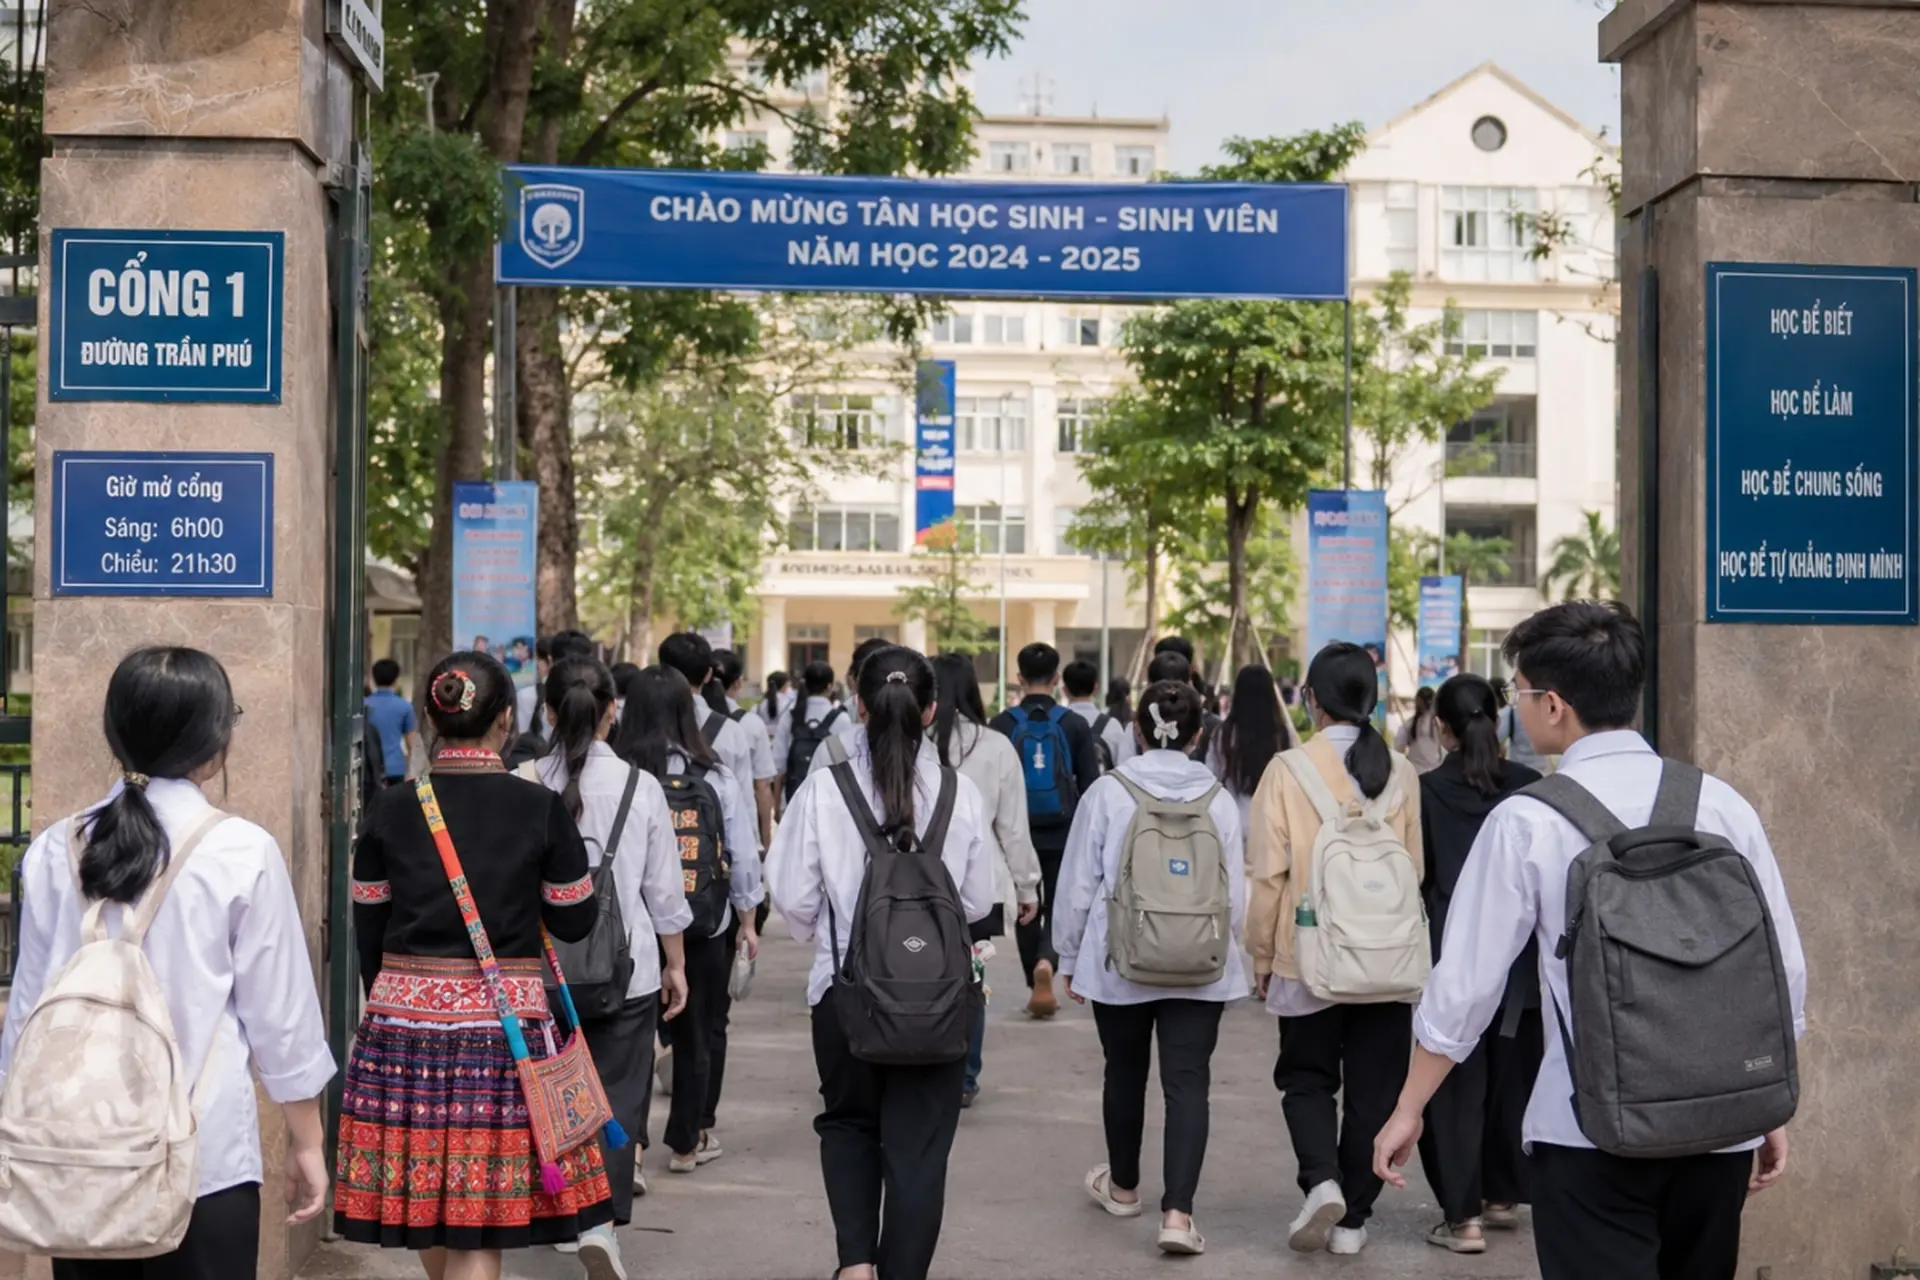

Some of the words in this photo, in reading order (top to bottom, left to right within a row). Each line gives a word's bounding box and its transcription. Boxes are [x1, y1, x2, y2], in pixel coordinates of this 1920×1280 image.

[651, 192, 741, 222] CHÀO
[752, 193, 848, 225] MỪNG
[859, 196, 919, 227] TÂN
[931, 203, 998, 234] HỌC
[1009, 205, 1084, 230] SINH
[1118, 207, 1193, 231] SINH
[1204, 203, 1277, 232] VIÊN
[788, 235, 859, 265] NĂM
[871, 243, 938, 273] HỌC
[948, 244, 1028, 268] 2024
[1061, 246, 1140, 271] 2025
[89, 251, 209, 317] CỔNG
[226, 272, 244, 317] 1
[1771, 309, 1799, 339] HỌC
[1803, 299, 1820, 334] ĐỂ
[1824, 302, 1852, 335] BIẾT
[81, 337, 148, 365] ĐƯỜNG
[155, 336, 206, 366] TRẦN
[213, 339, 252, 367] PHÚ
[1771, 390, 1798, 420] HỌC
[1803, 380, 1820, 415] ĐỂ
[1825, 384, 1852, 416] LÀM
[107, 475, 137, 497] Giờ
[143, 475, 172, 497] mở
[178, 472, 222, 502] cổng
[1742, 470, 1769, 500] HỌC
[1773, 460, 1790, 495] ĐỂ
[1795, 471, 1841, 496] CHUNG
[1846, 463, 1882, 497] SỐNG
[105, 517, 157, 541] Sáng:
[172, 518, 223, 538] 6h00
[102, 549, 158, 573] Chiều:
[172, 553, 236, 573] 21h30
[1721, 552, 1746, 582] HỌC
[1749, 540, 1766, 577] ĐỂ
[1769, 549, 1786, 583] TỰ
[1836, 553, 1866, 583] ĐỊNH
[1870, 548, 1902, 578] MÌNH
